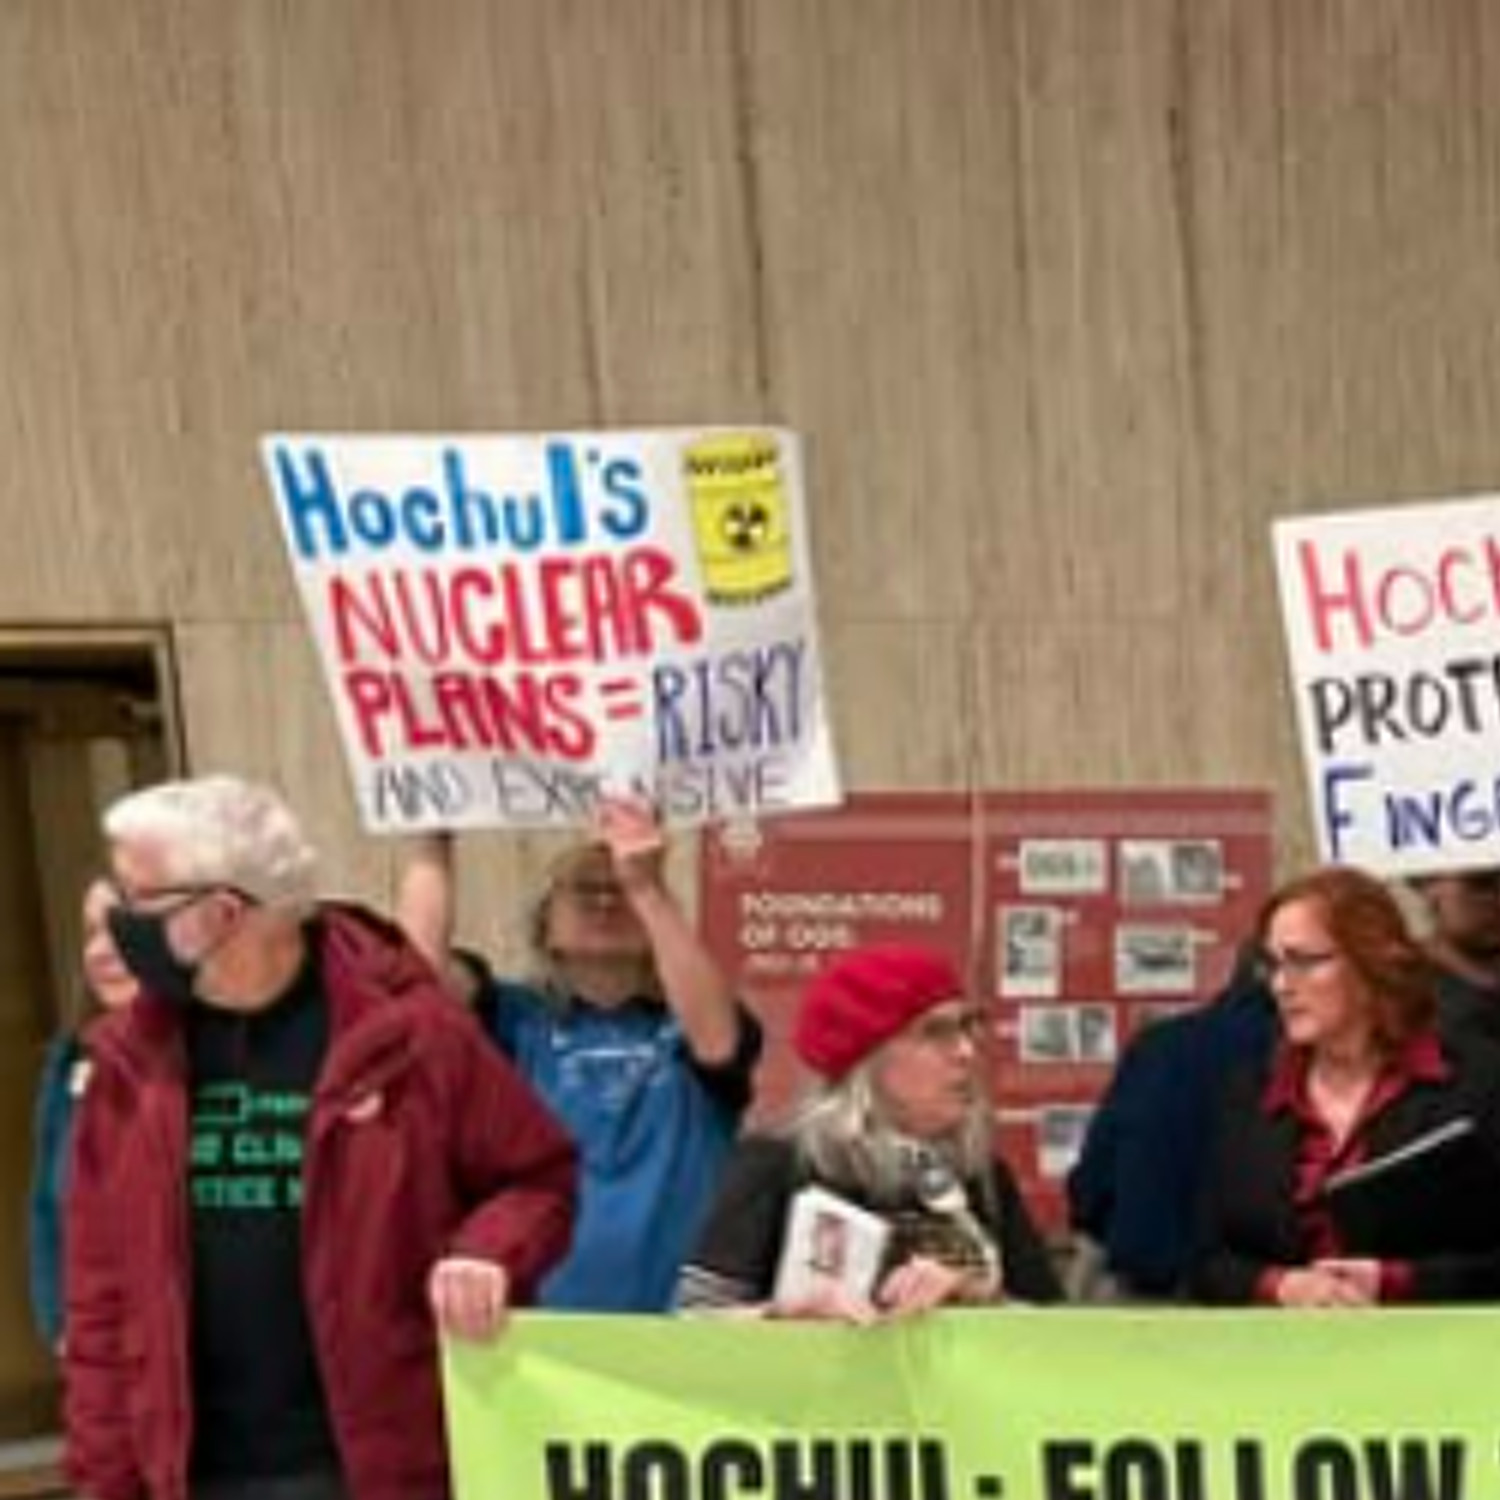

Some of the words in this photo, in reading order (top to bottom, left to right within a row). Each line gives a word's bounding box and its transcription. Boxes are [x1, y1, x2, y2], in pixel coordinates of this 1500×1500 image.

[273, 443, 649, 558] Hochul's
[329, 548, 701, 664] NUCLEAR
[374, 764, 465, 822] AND
